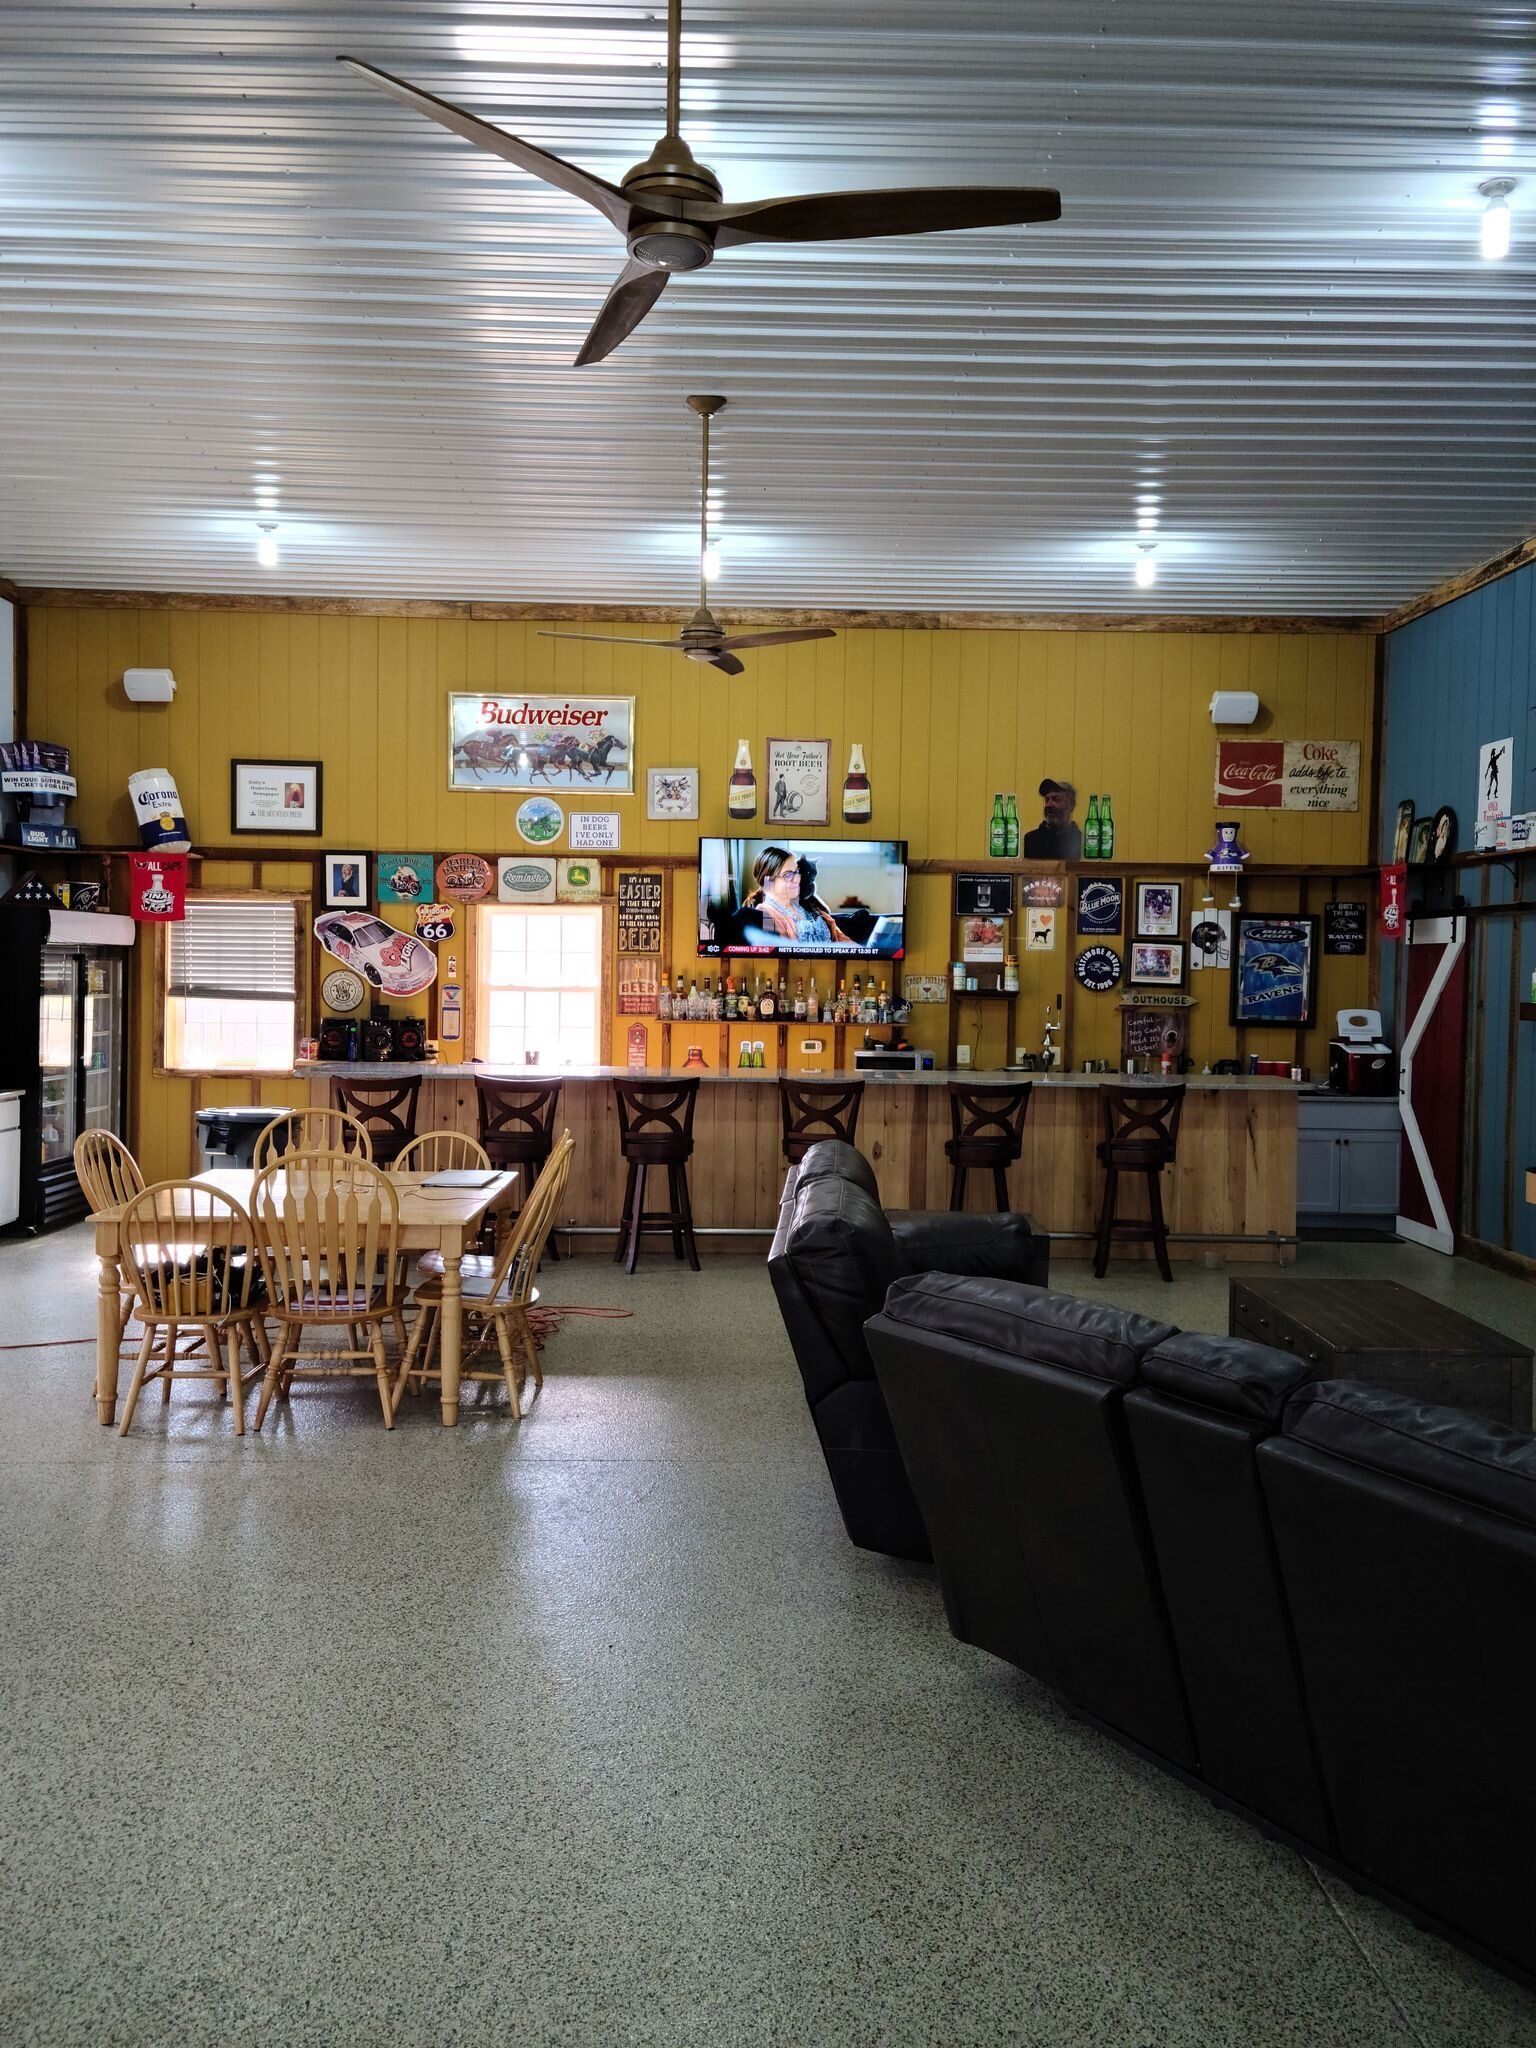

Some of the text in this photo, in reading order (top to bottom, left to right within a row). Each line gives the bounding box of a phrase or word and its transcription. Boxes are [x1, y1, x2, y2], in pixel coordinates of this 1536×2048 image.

[477, 701, 608, 726] Budweiser
[1303, 743, 1338, 760] Coke
[799, 760, 823, 768] BEER
[1223, 763, 1278, 781] Coca-Cola
[1289, 764, 1314, 778] adds
[1315, 764, 1335, 783] life
[40, 777, 61, 785] SUPER
[1290, 784, 1348, 798] everything
[138, 790, 178, 806] Corona
[1307, 796, 1330, 808] nice
[152, 801, 172, 809] Extra
[147, 861, 162, 872] ALL
[446, 857, 482, 866] HARLEY
[504, 873, 550, 883] Remington
[619, 884, 661, 900] EASIER
[1023, 880, 1040, 892] MAN
[1041, 880, 1062, 893] CAVE
[1080, 894, 1120, 913] BLUE MOON
[423, 924, 448, 938] 66
[618, 928, 660, 951] BEER
[728, 945, 750, 953] COMING
[400, 940, 419, 972] LIGHT
[1078, 947, 1120, 977] BALTIMORE RAVENS
[621, 982, 655, 993] BEER
[1133, 996, 1187, 1005] OUTHOUSE
[1246, 984, 1302, 1005] RAVENS
[1128, 1016, 1154, 1026] Careful
[1130, 1037, 1148, 1045] Hold
